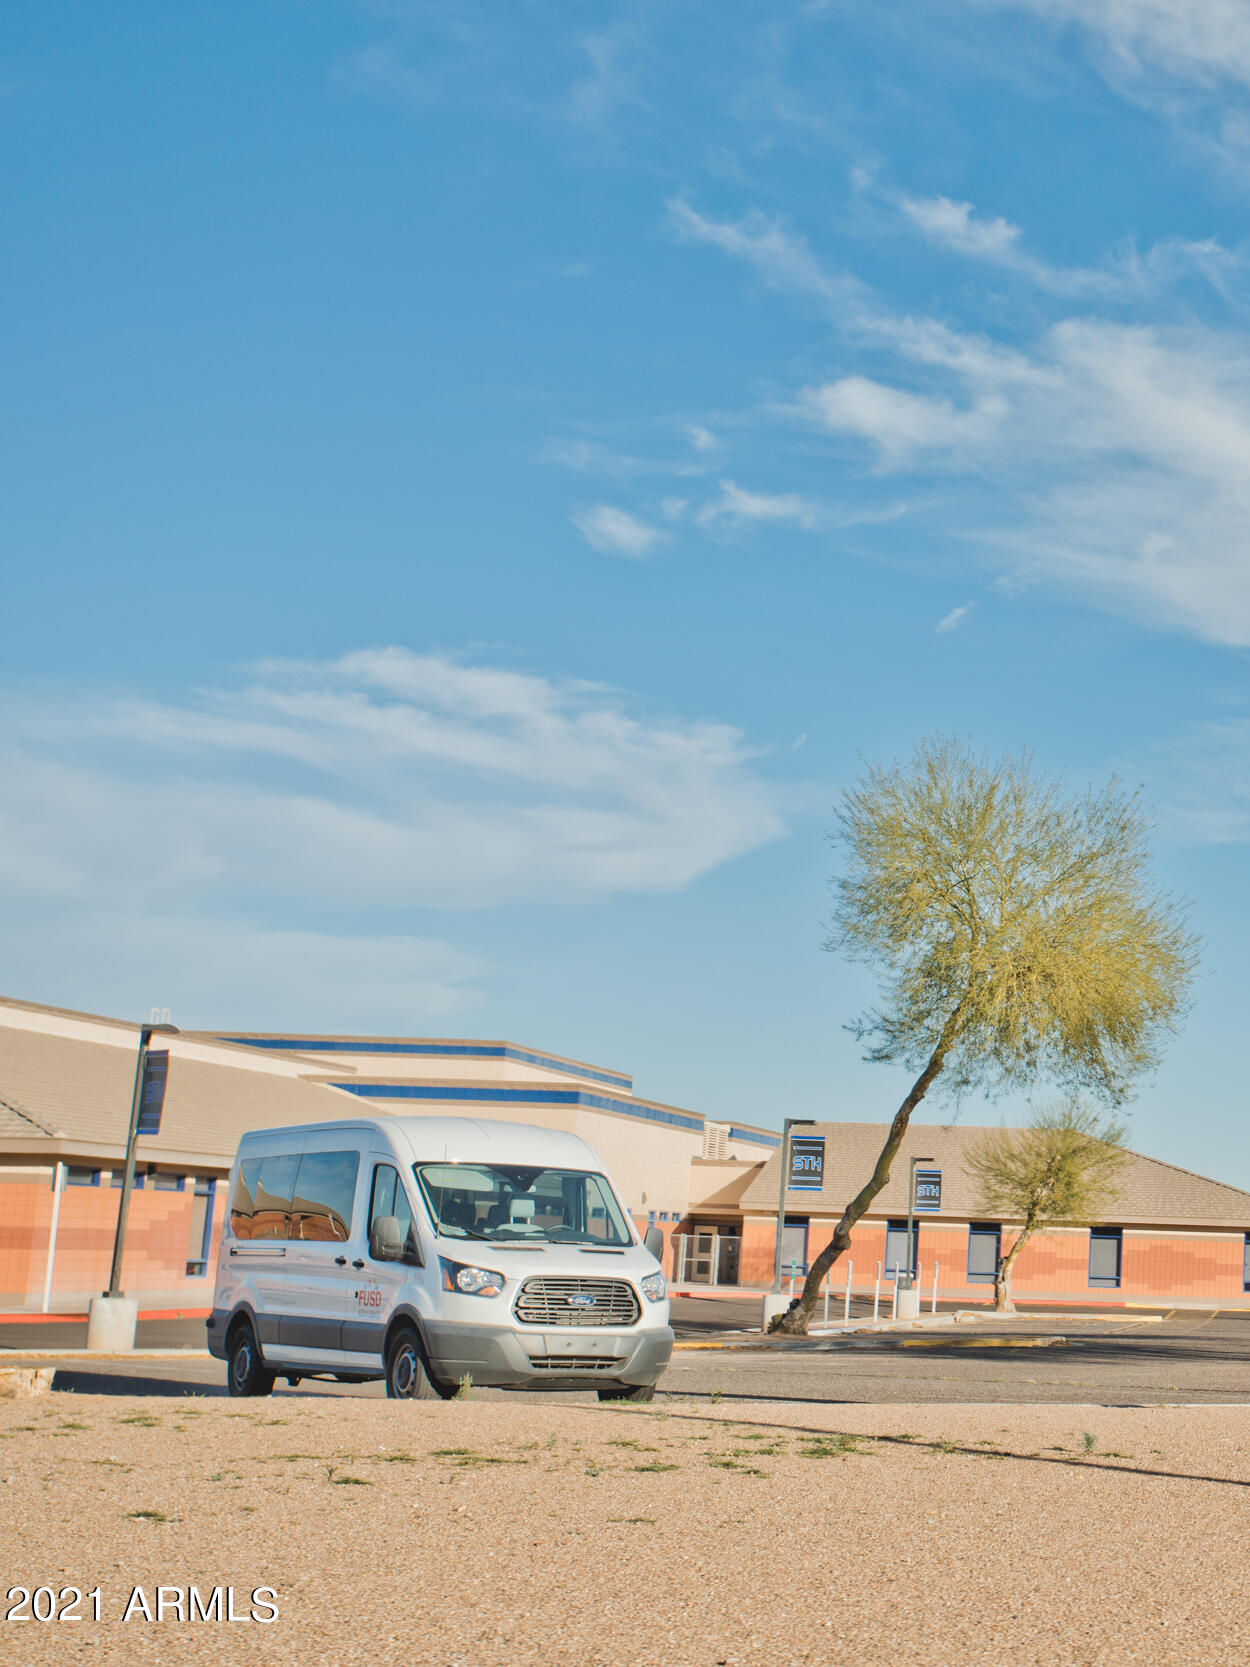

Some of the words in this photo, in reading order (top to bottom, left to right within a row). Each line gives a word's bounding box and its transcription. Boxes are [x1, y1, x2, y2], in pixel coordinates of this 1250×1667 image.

[792, 1155, 823, 1171] STH
[917, 1184, 940, 1197] STH
[358, 1290, 382, 1307] FUSD
